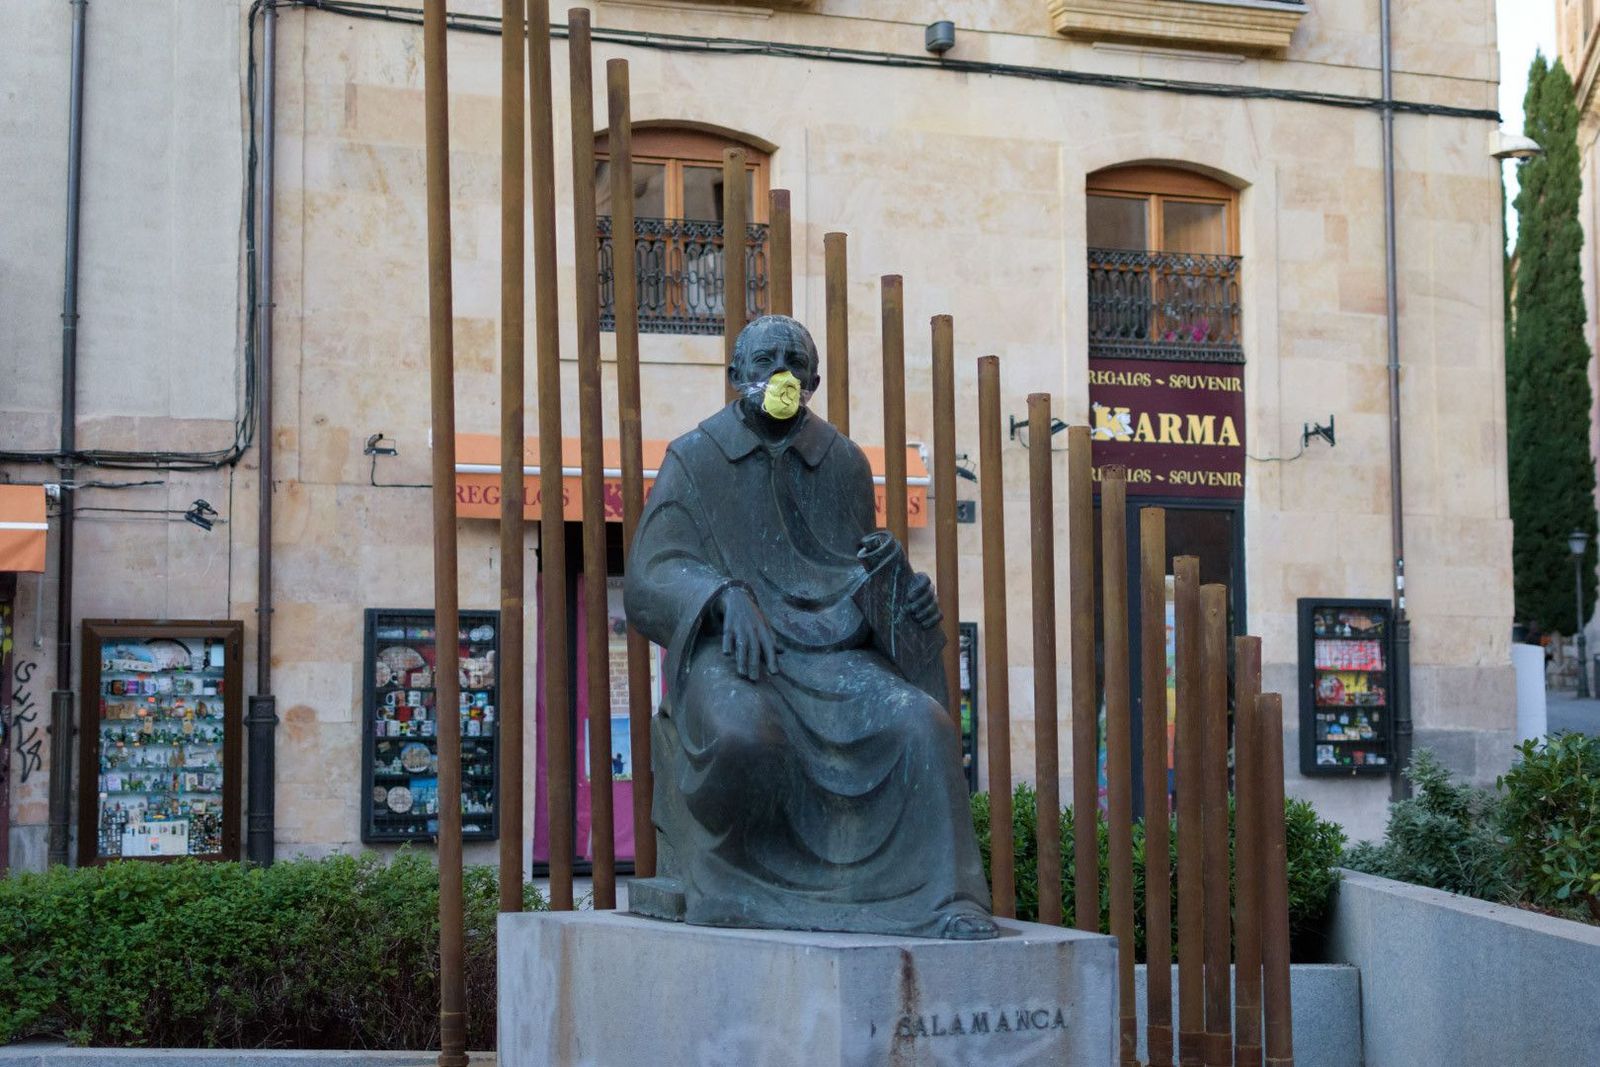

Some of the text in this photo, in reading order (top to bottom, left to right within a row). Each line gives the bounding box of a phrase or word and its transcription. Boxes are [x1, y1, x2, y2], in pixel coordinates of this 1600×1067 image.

[1088, 370, 1151, 387] REGALOS
[1169, 374, 1242, 392] SOUVENIR
[1092, 404, 1240, 446] KARMA
[1169, 471, 1242, 487] SOUVENIR
[896, 1008, 1068, 1038] SALAMANCA
